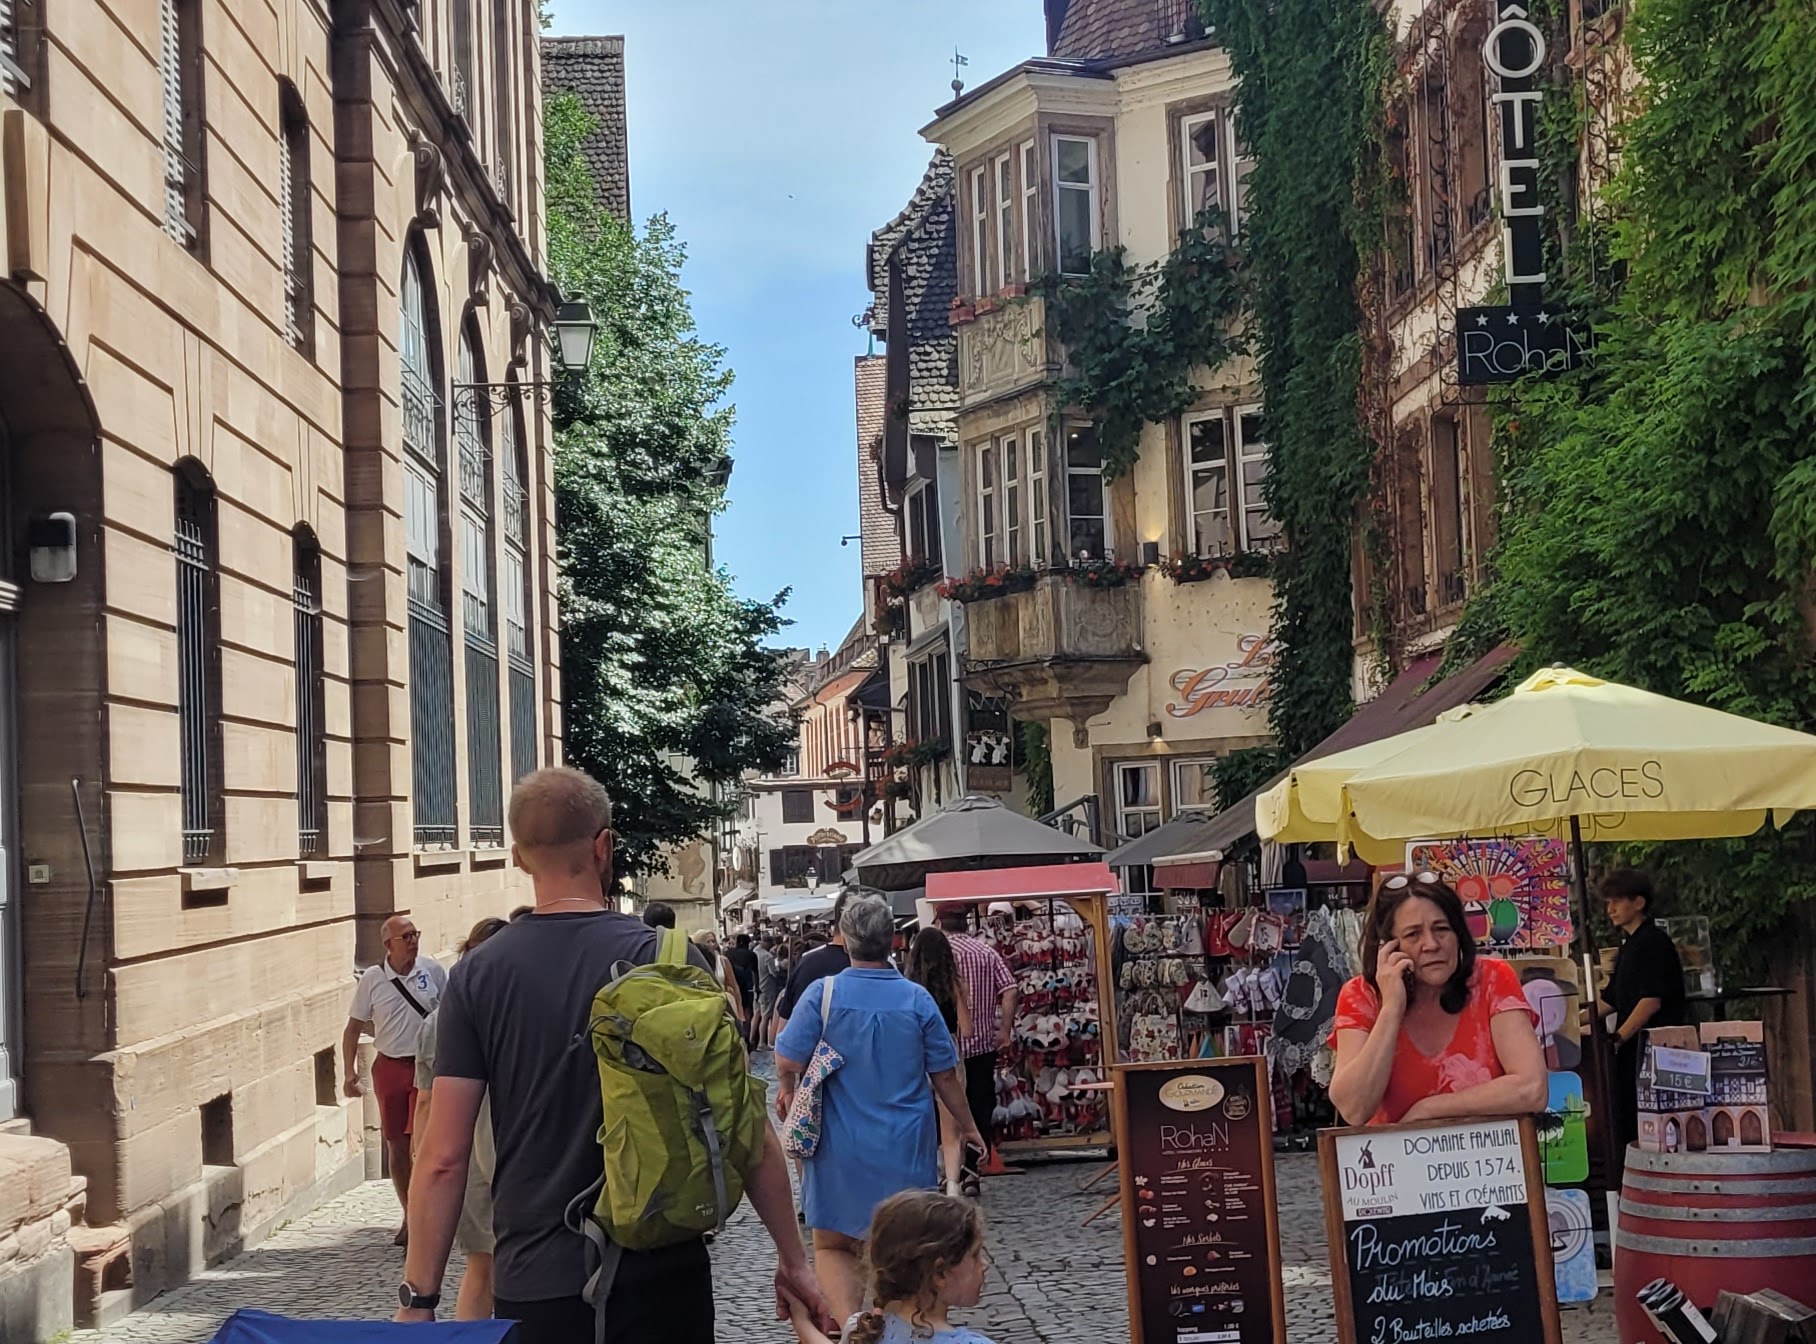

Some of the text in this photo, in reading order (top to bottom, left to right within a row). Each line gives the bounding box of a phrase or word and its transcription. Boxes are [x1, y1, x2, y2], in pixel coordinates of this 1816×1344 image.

[1509, 759, 1665, 808] GLACES
[1669, 1074, 1693, 1088] 15 €
[1160, 1121, 1230, 1149] RohaN
[1403, 1128, 1518, 1156] DOMAINE FAMILIAL
[1344, 1163, 1395, 1195] Dopff
[1427, 1157, 1521, 1182] DEPUIS 1574.
[1346, 1192, 1399, 1206] AU MOULIN
[1419, 1184, 1526, 1210] VINS ET CRÉMANTS
[1350, 1218, 1497, 1271] Promotions
[1366, 1273, 1406, 1304] du
[1413, 1270, 1454, 1299] Mois
